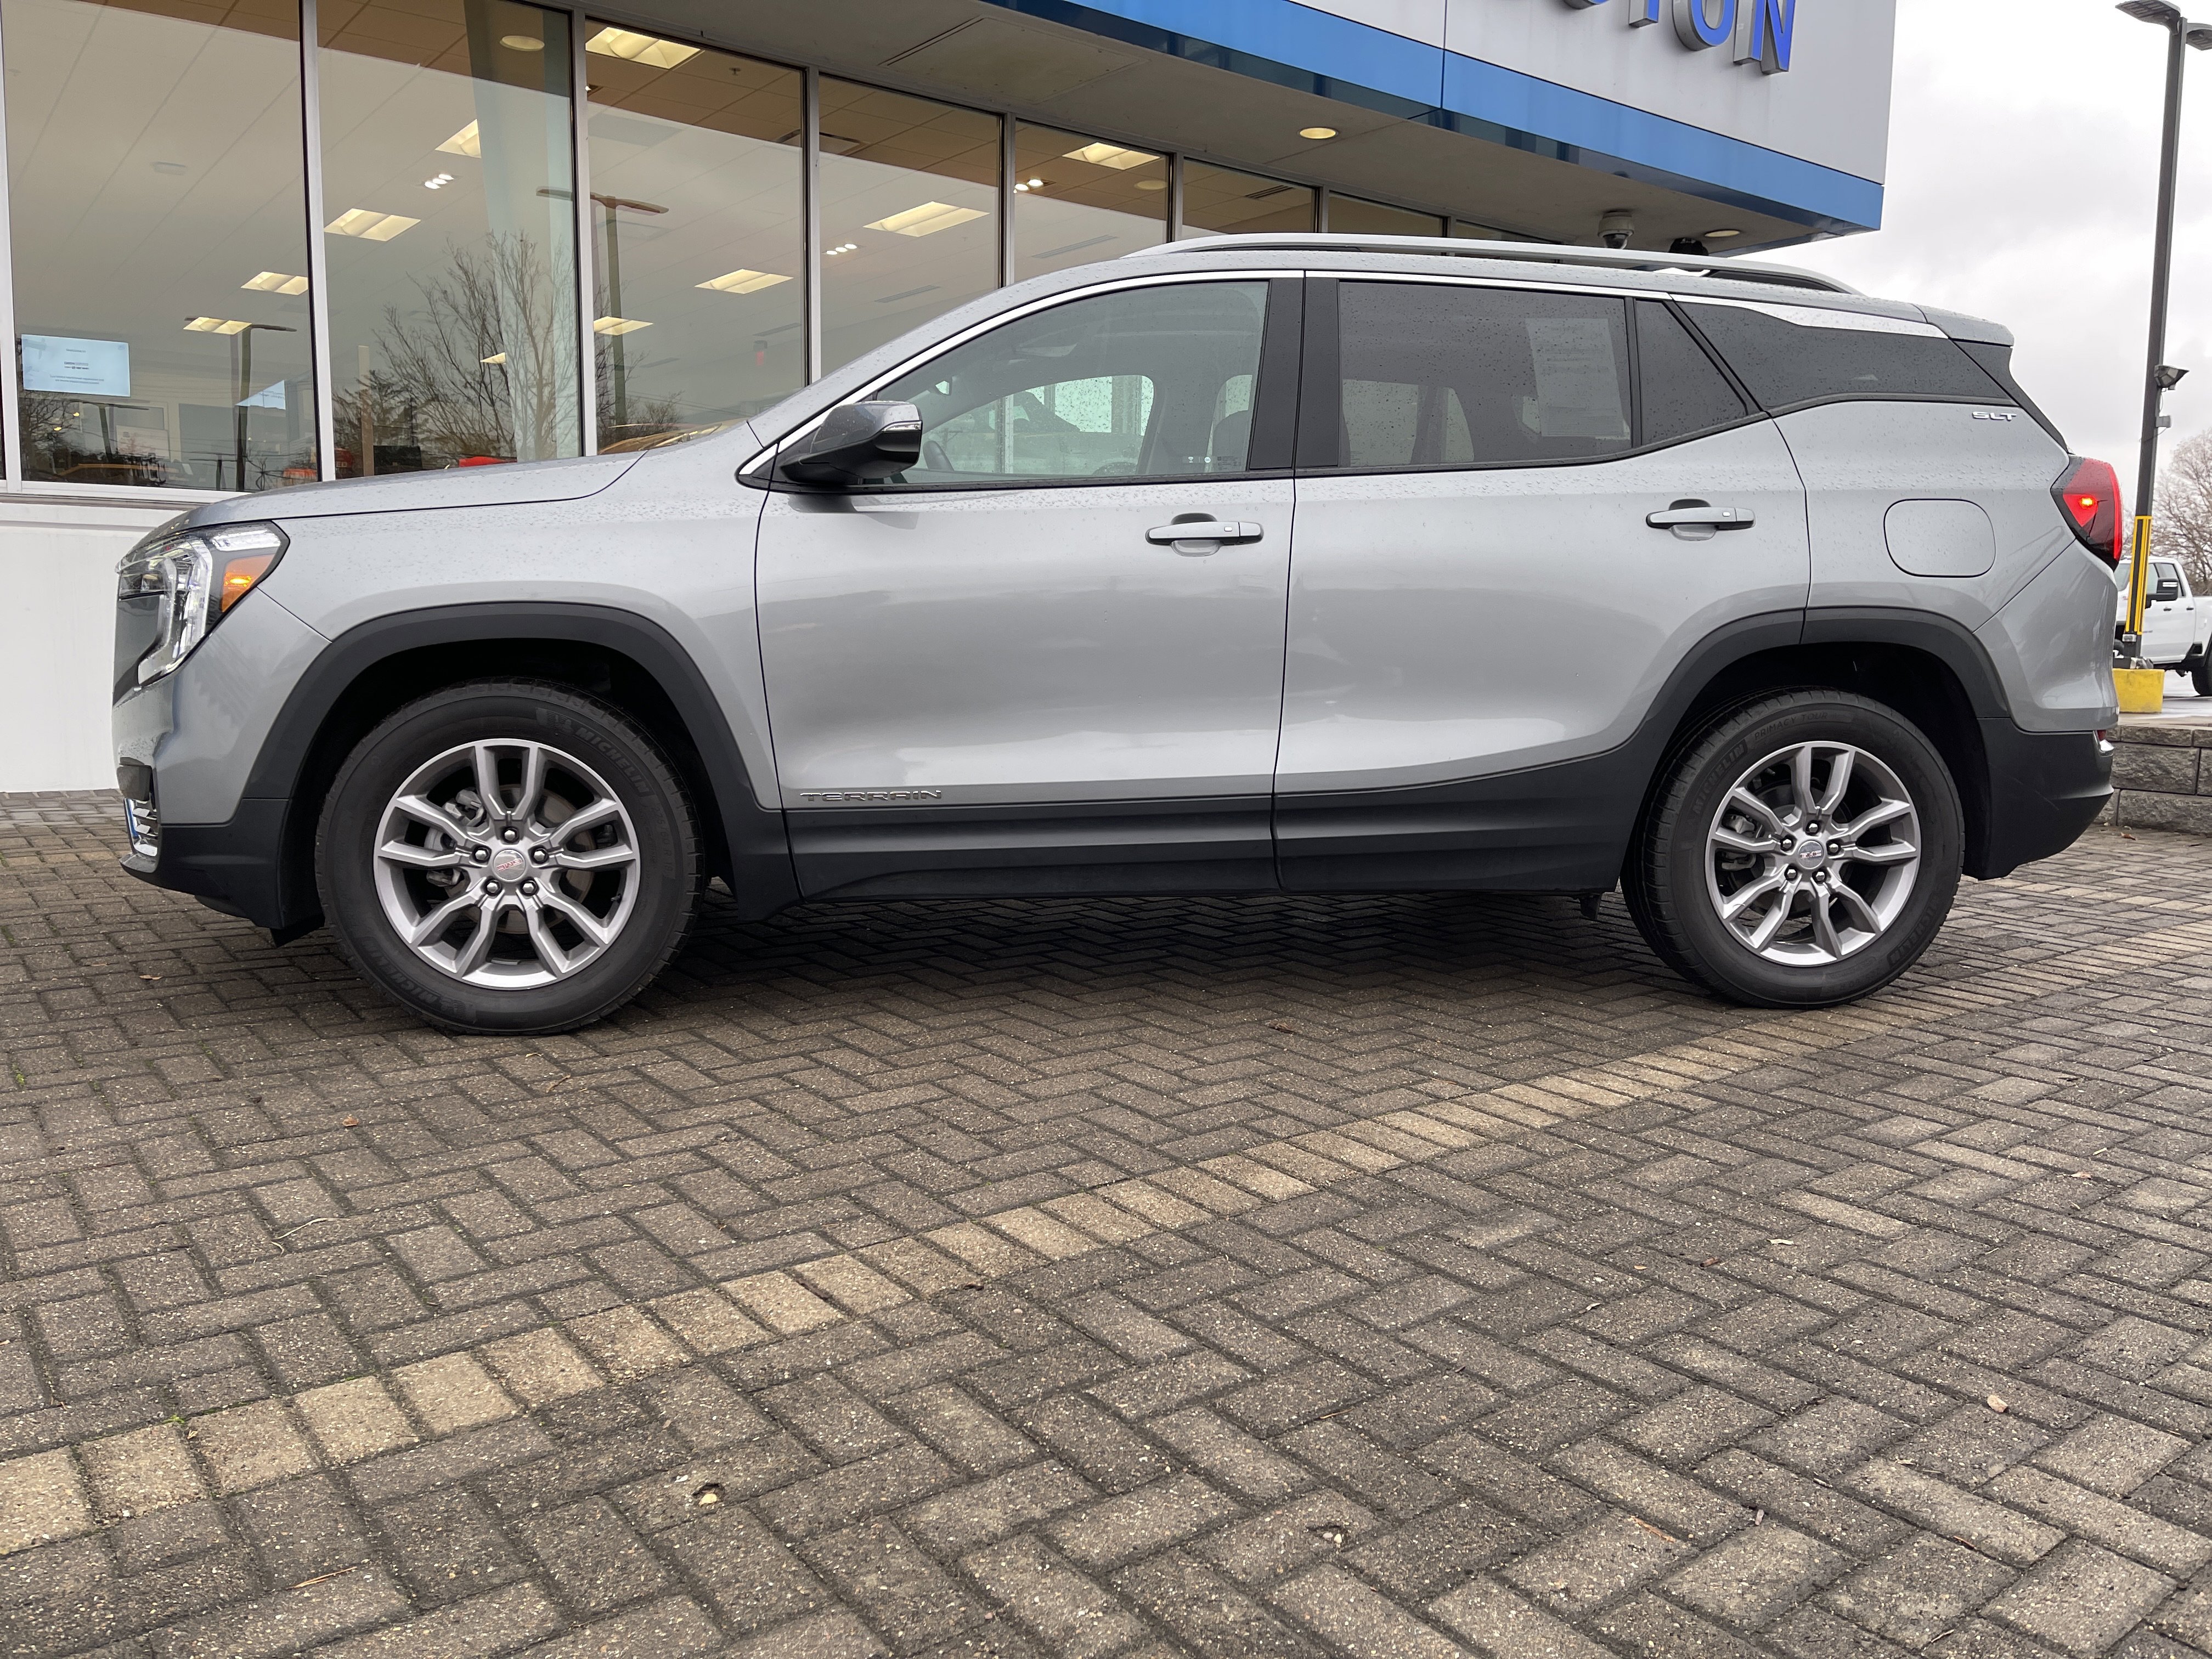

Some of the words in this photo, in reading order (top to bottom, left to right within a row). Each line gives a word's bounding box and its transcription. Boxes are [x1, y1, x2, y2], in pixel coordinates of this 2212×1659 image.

[1971, 411, 2017, 421] SLT
[1754, 716, 1797, 740] PRIMACY
[1802, 713, 1829, 721] TOUR
[575, 727, 650, 794] MICHELIN
[800, 790, 942, 802] TERRAIN
[1800, 850, 1821, 859] GMC
[496, 858, 523, 872] GMC
